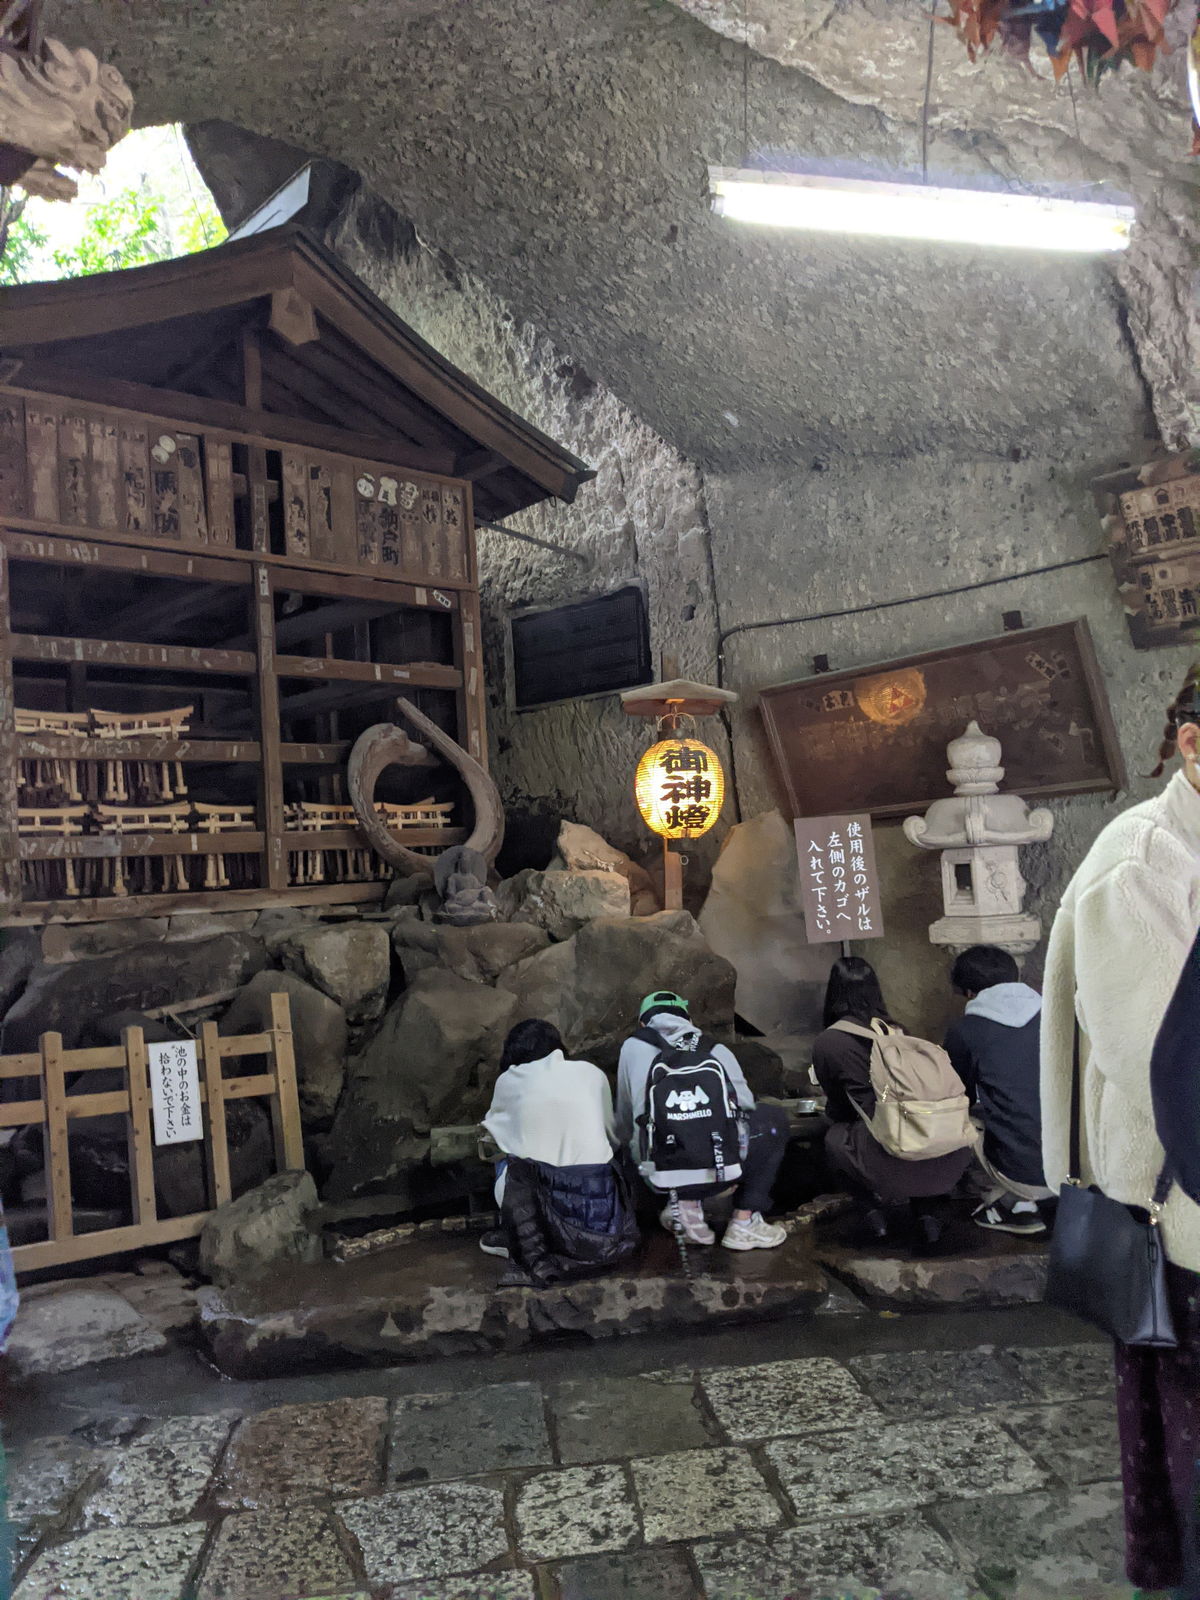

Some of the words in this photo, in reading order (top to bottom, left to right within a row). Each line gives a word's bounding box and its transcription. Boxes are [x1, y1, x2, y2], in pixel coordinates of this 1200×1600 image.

[659, 747, 711, 829] 御神燈
[807, 840, 832, 934] 入れて下さい。
[827, 831, 851, 920] 左側のカゴへ
[847, 821, 873, 931] 使用後のザルは
[160, 1052, 177, 1138] 拾わないで下さい
[175, 1046, 192, 1127] 池の中のお金は
[667, 1108, 713, 1121] MARSHMELLO
